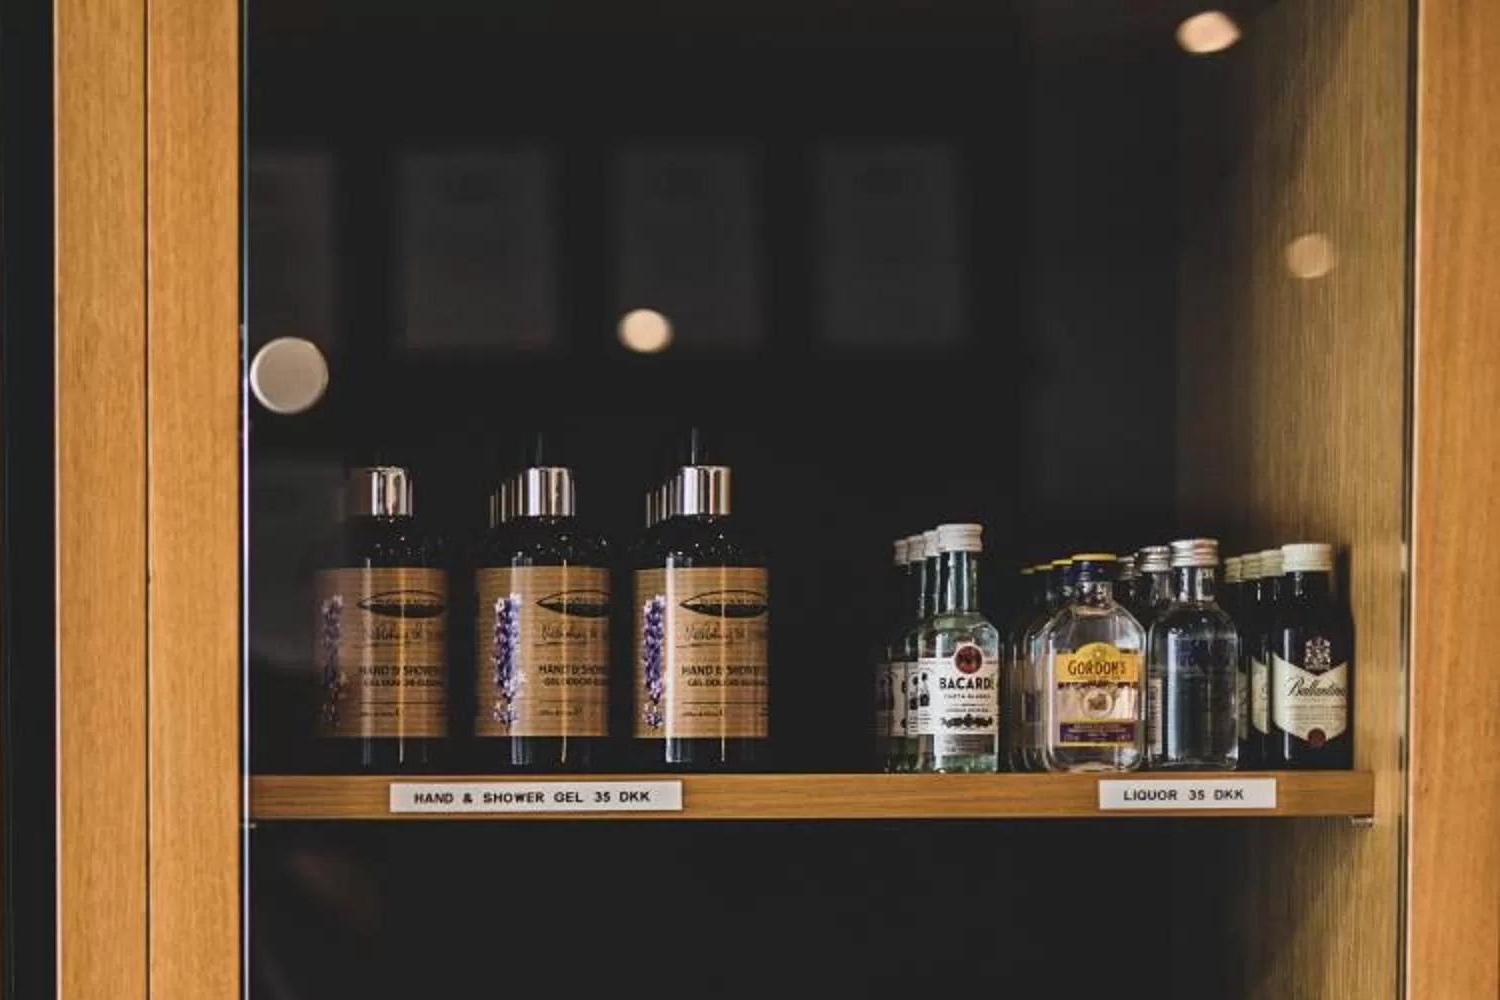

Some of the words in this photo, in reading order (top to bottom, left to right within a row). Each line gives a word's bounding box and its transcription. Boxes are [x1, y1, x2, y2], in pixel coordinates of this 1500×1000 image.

[413, 792, 454, 804] HAND
[463, 793, 473, 804] &
[483, 791, 545, 804] SHOWER
[553, 791, 583, 803] GEL
[595, 791, 611, 802] 35
[619, 790, 650, 802] DKK
[1123, 789, 1178, 801] LIQUOR
[1214, 789, 1245, 800] DKK
